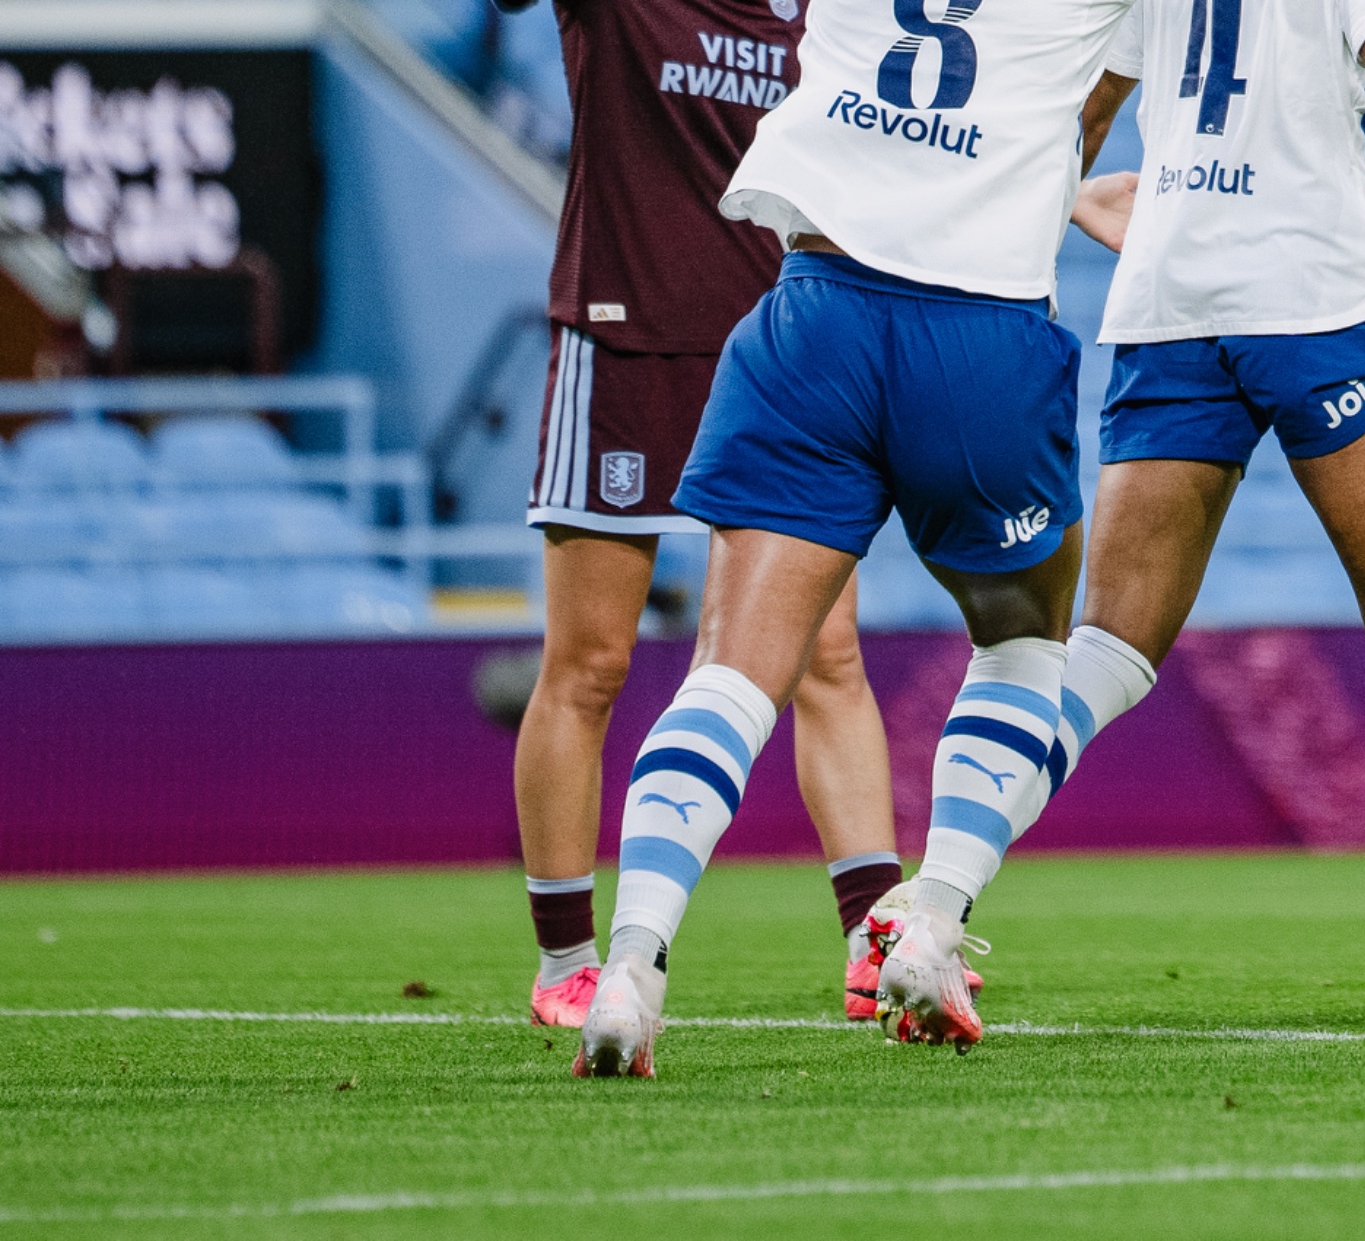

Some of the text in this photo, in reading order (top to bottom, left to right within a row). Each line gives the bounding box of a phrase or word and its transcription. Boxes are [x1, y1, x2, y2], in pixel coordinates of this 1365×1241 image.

[698, 32, 787, 78] VISIT
[659, 61, 791, 111] RWAND
[826, 89, 984, 160] Revolut
